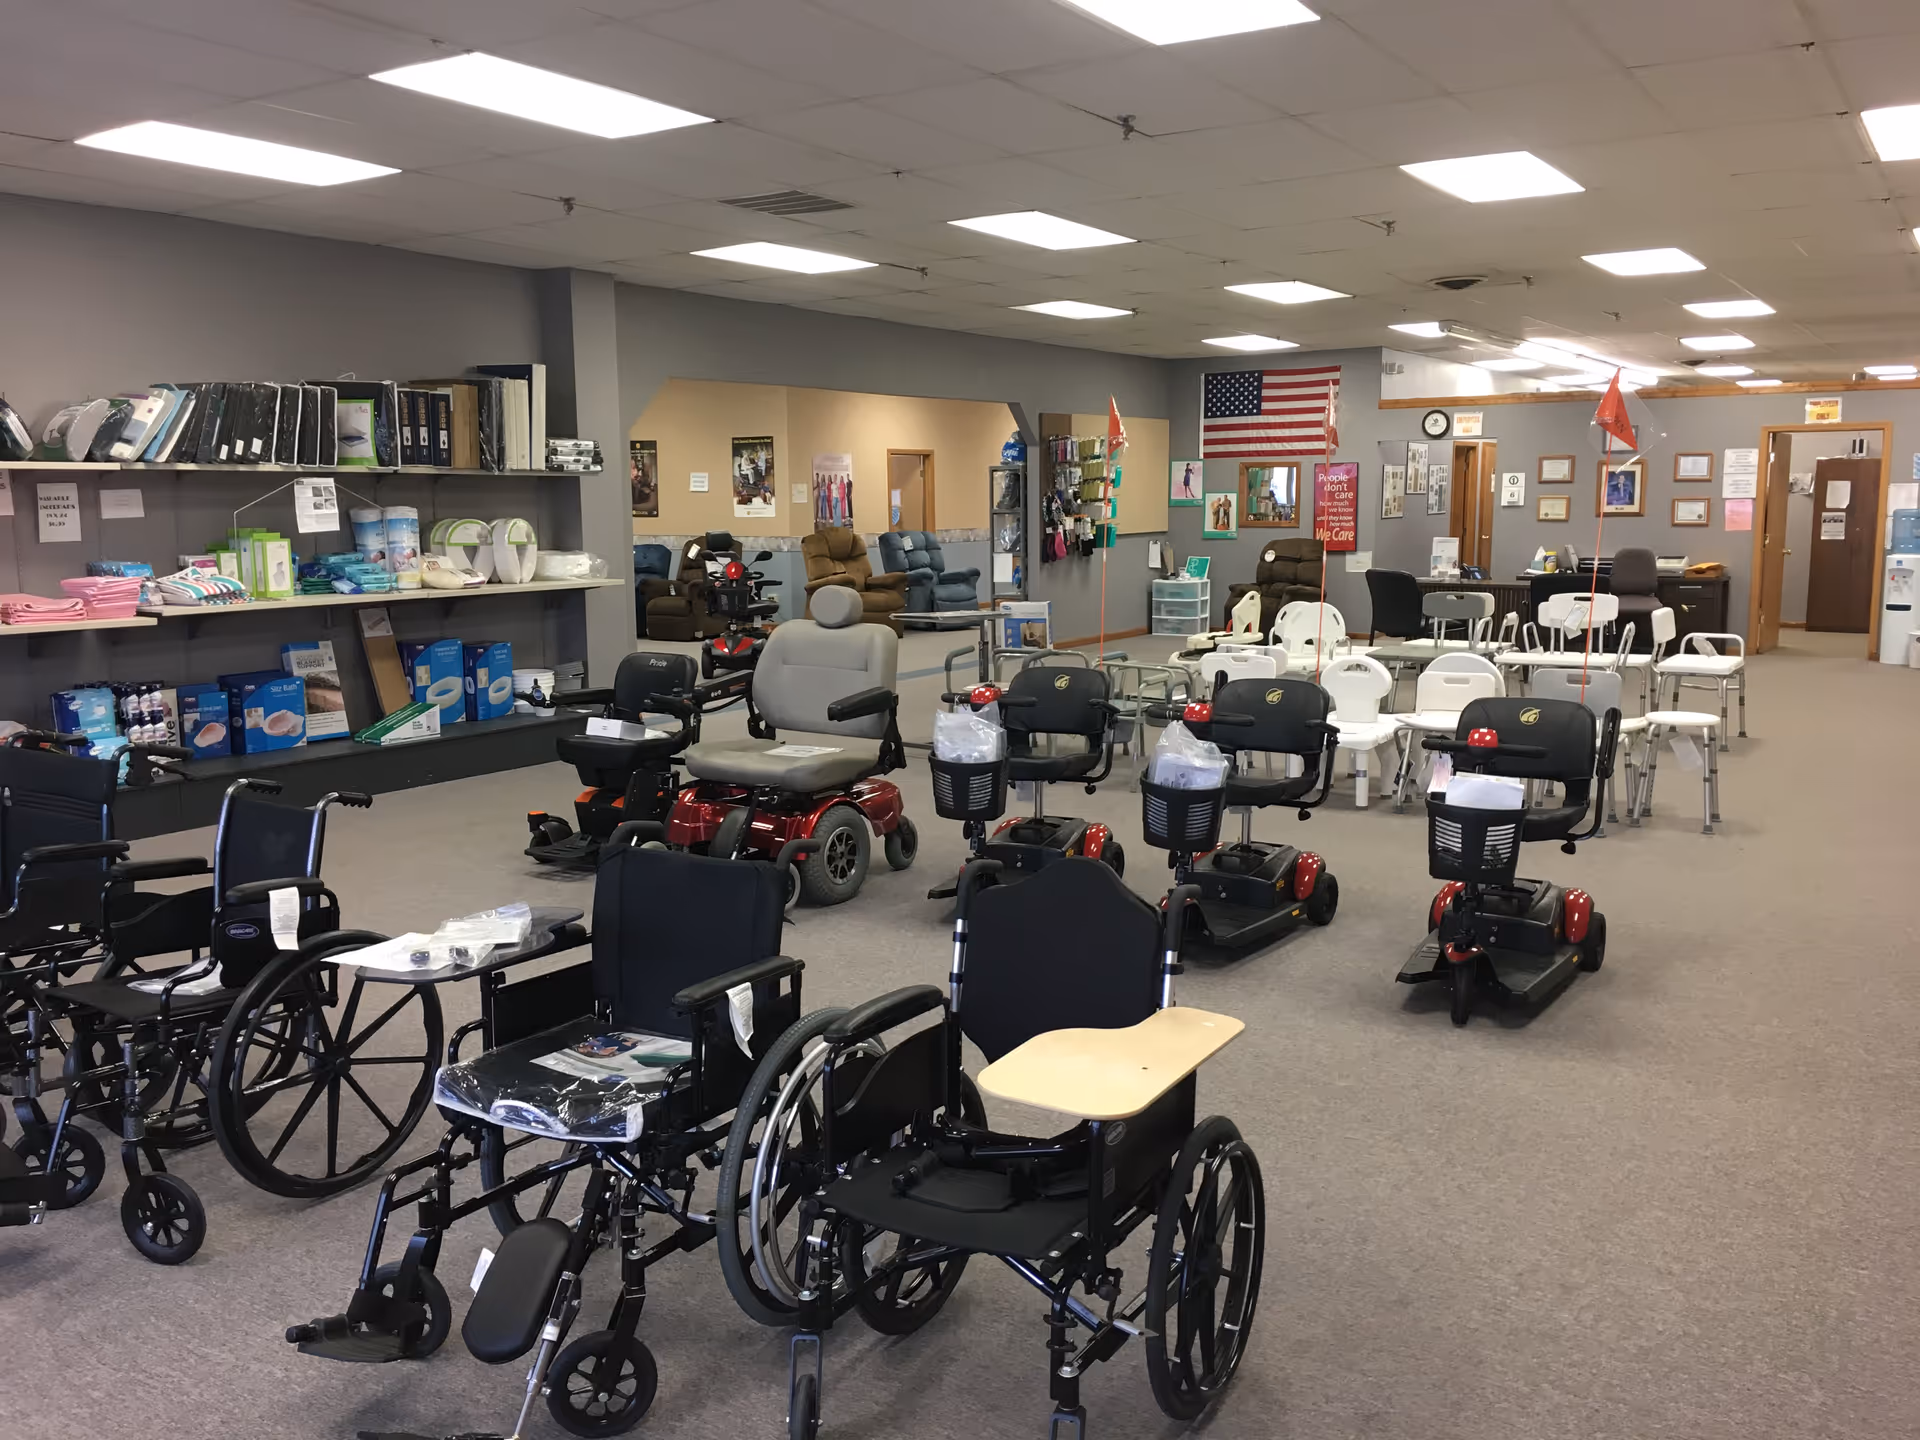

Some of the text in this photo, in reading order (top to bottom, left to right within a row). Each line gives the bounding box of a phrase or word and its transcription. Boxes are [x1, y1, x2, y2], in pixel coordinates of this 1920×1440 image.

[1318, 472, 1348, 484] People
[1324, 482, 1348, 492] don't
[1316, 528, 1354, 541] We Care
[648, 658, 668, 668] Pride
